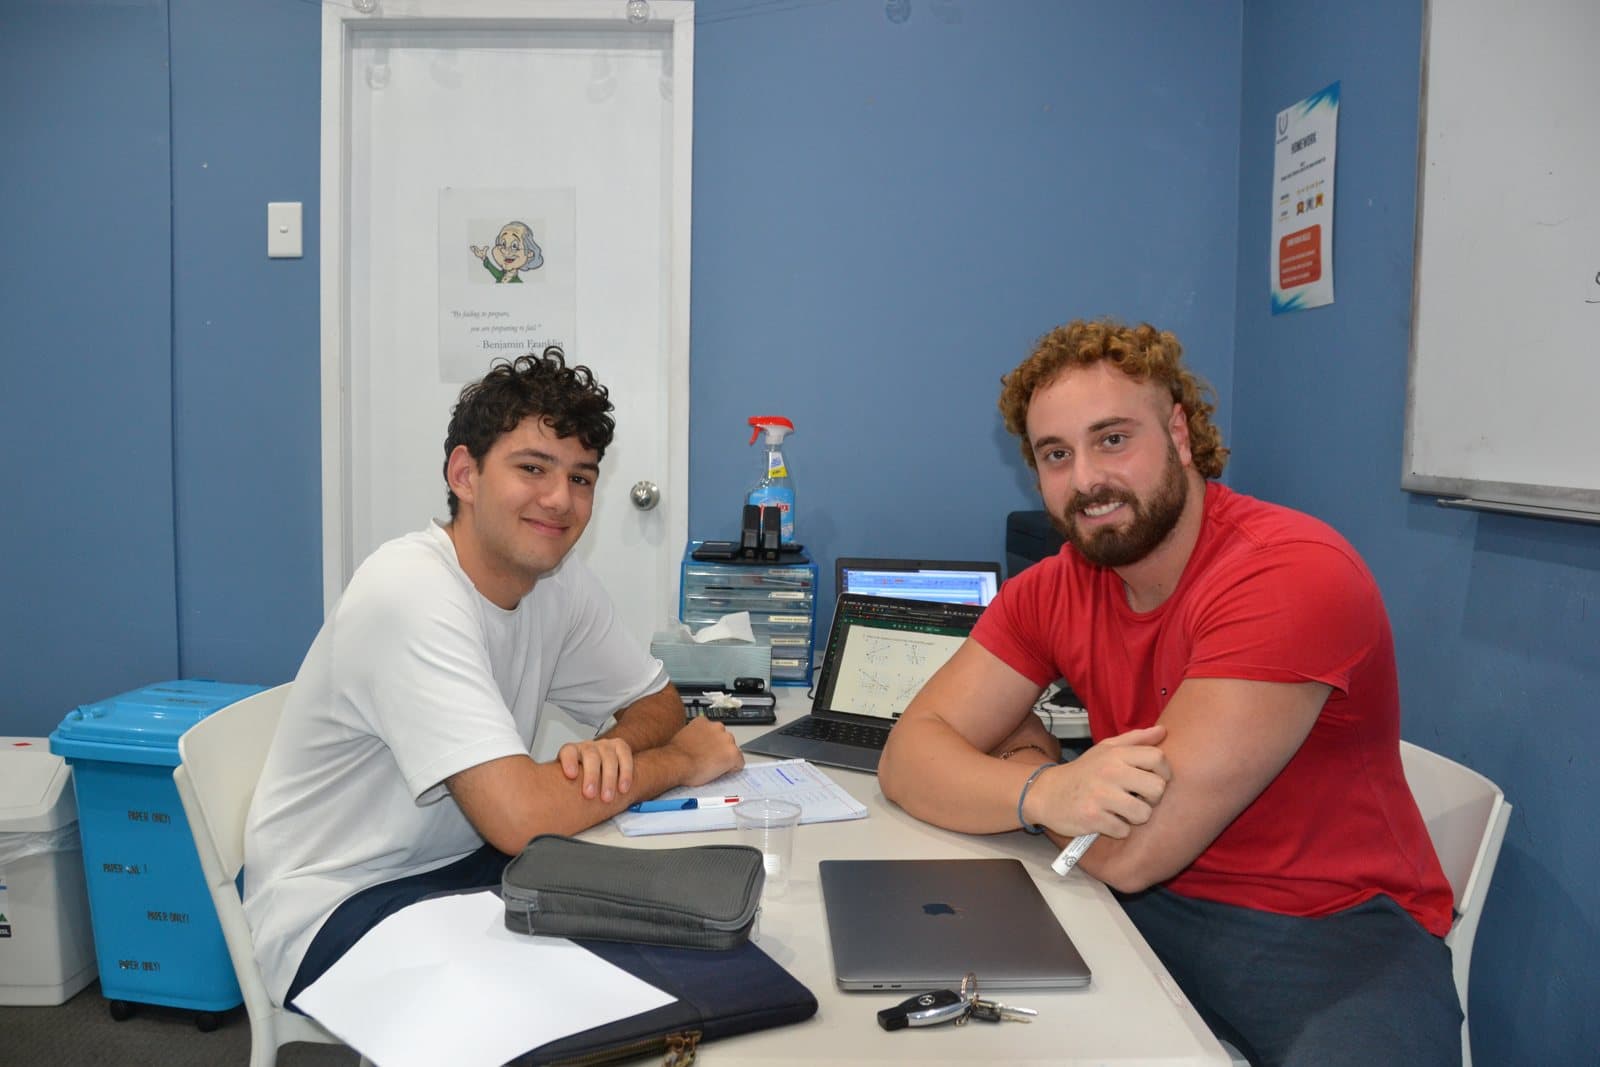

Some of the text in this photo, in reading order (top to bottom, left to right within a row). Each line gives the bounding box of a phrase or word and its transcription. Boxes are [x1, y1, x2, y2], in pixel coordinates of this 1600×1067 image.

[483, 340, 524, 350] Benjamin
[527, 339, 563, 348] Franklin
[128, 810, 148, 822] PAPER
[103, 863, 123, 873] PAPER
[147, 910, 168, 921] PAPER
[119, 959, 139, 970] PAPER
